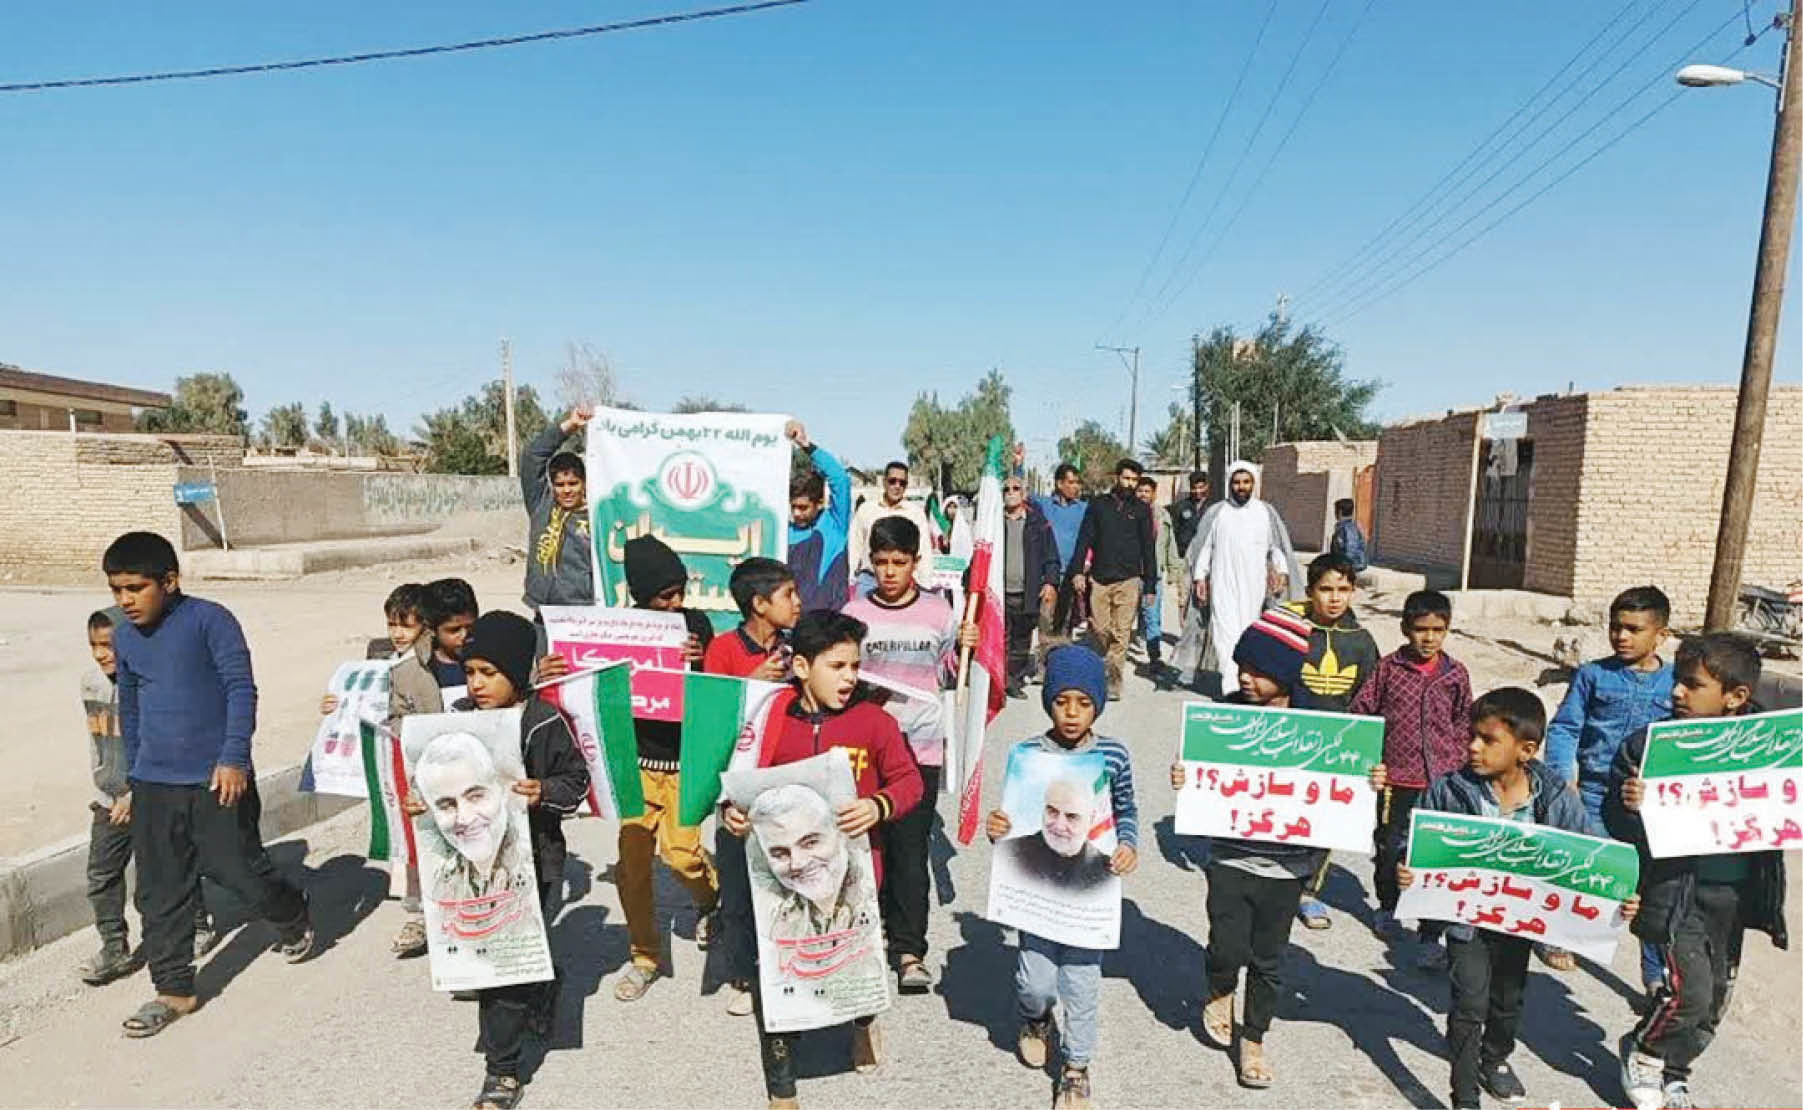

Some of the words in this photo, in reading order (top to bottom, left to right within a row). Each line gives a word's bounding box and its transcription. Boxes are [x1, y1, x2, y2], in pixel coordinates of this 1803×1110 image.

[661, 428, 702, 441] بهمن
[725, 430, 750, 442] الله
[752, 428, 779, 447] یوم
[866, 640, 931, 653] CATERPILLAR
[572, 646, 662, 676] امرکا
[1226, 716, 1299, 751] اسلامی
[1259, 729, 1325, 760] انقلاب
[1305, 780, 1321, 805] و
[1329, 777, 1355, 805] ما
[1782, 778, 1797, 805] و
[1496, 848, 1571, 868] انقلاب
[1543, 893, 1560, 911] و
[1571, 895, 1600, 920] ما
